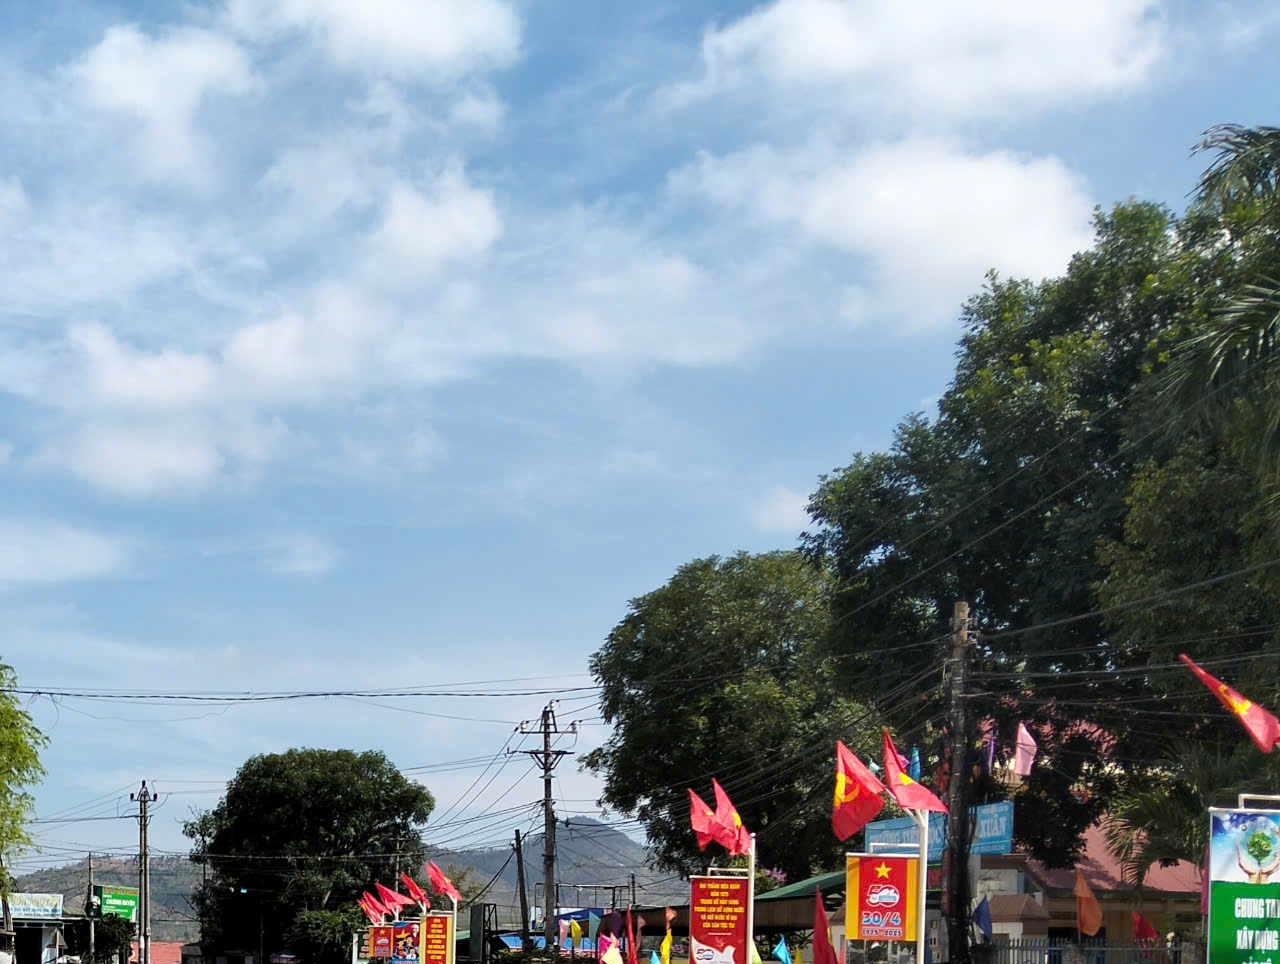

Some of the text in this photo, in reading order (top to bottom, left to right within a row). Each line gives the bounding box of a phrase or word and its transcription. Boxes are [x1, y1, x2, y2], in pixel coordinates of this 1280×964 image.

[1235, 898, 1265, 918] CHUNG
[862, 910, 902, 928] 30/4
[1236, 926, 1279, 953] XÂY DỰNG
